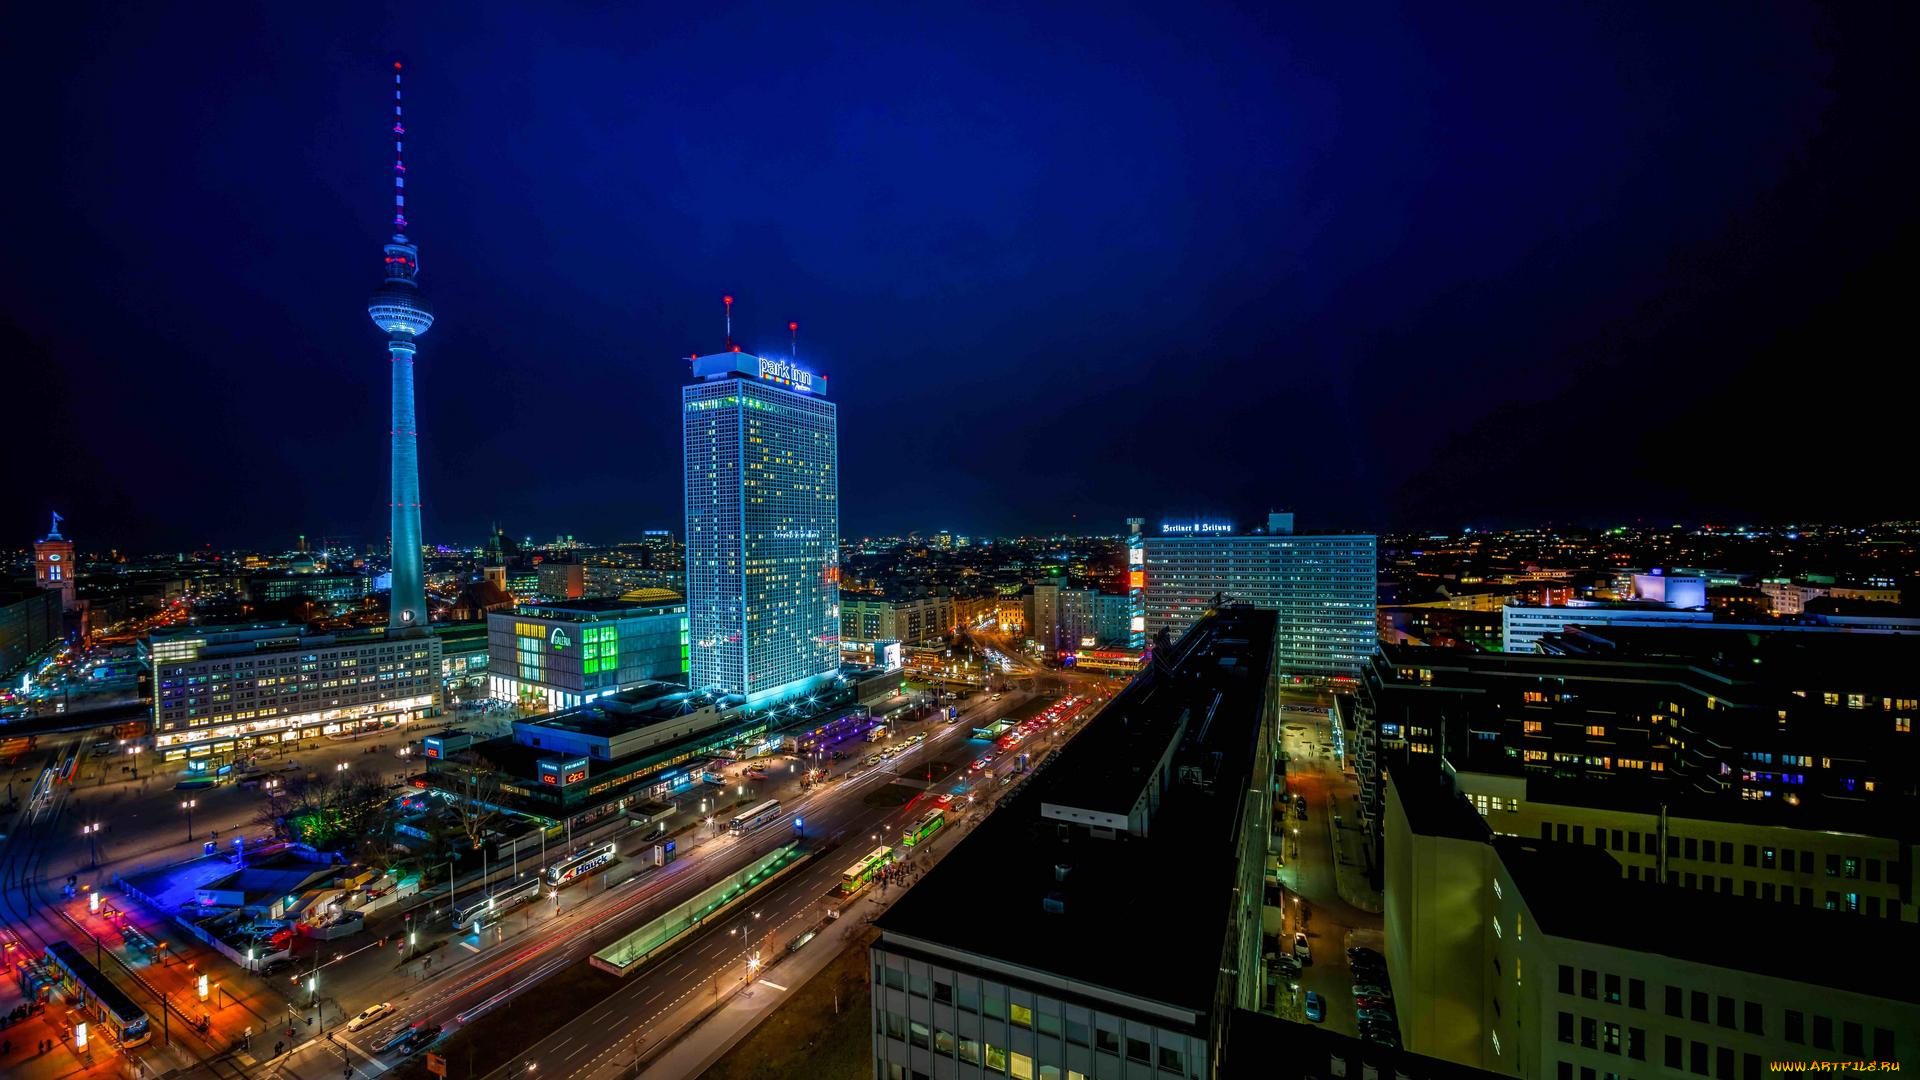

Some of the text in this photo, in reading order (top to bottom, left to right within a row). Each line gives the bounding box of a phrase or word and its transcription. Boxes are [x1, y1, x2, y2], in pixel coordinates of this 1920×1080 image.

[759, 358, 811, 386] park inn
[544, 775, 556, 784] CCC
[568, 772, 584, 782] CCC
[576, 855, 607, 875] Hauck
